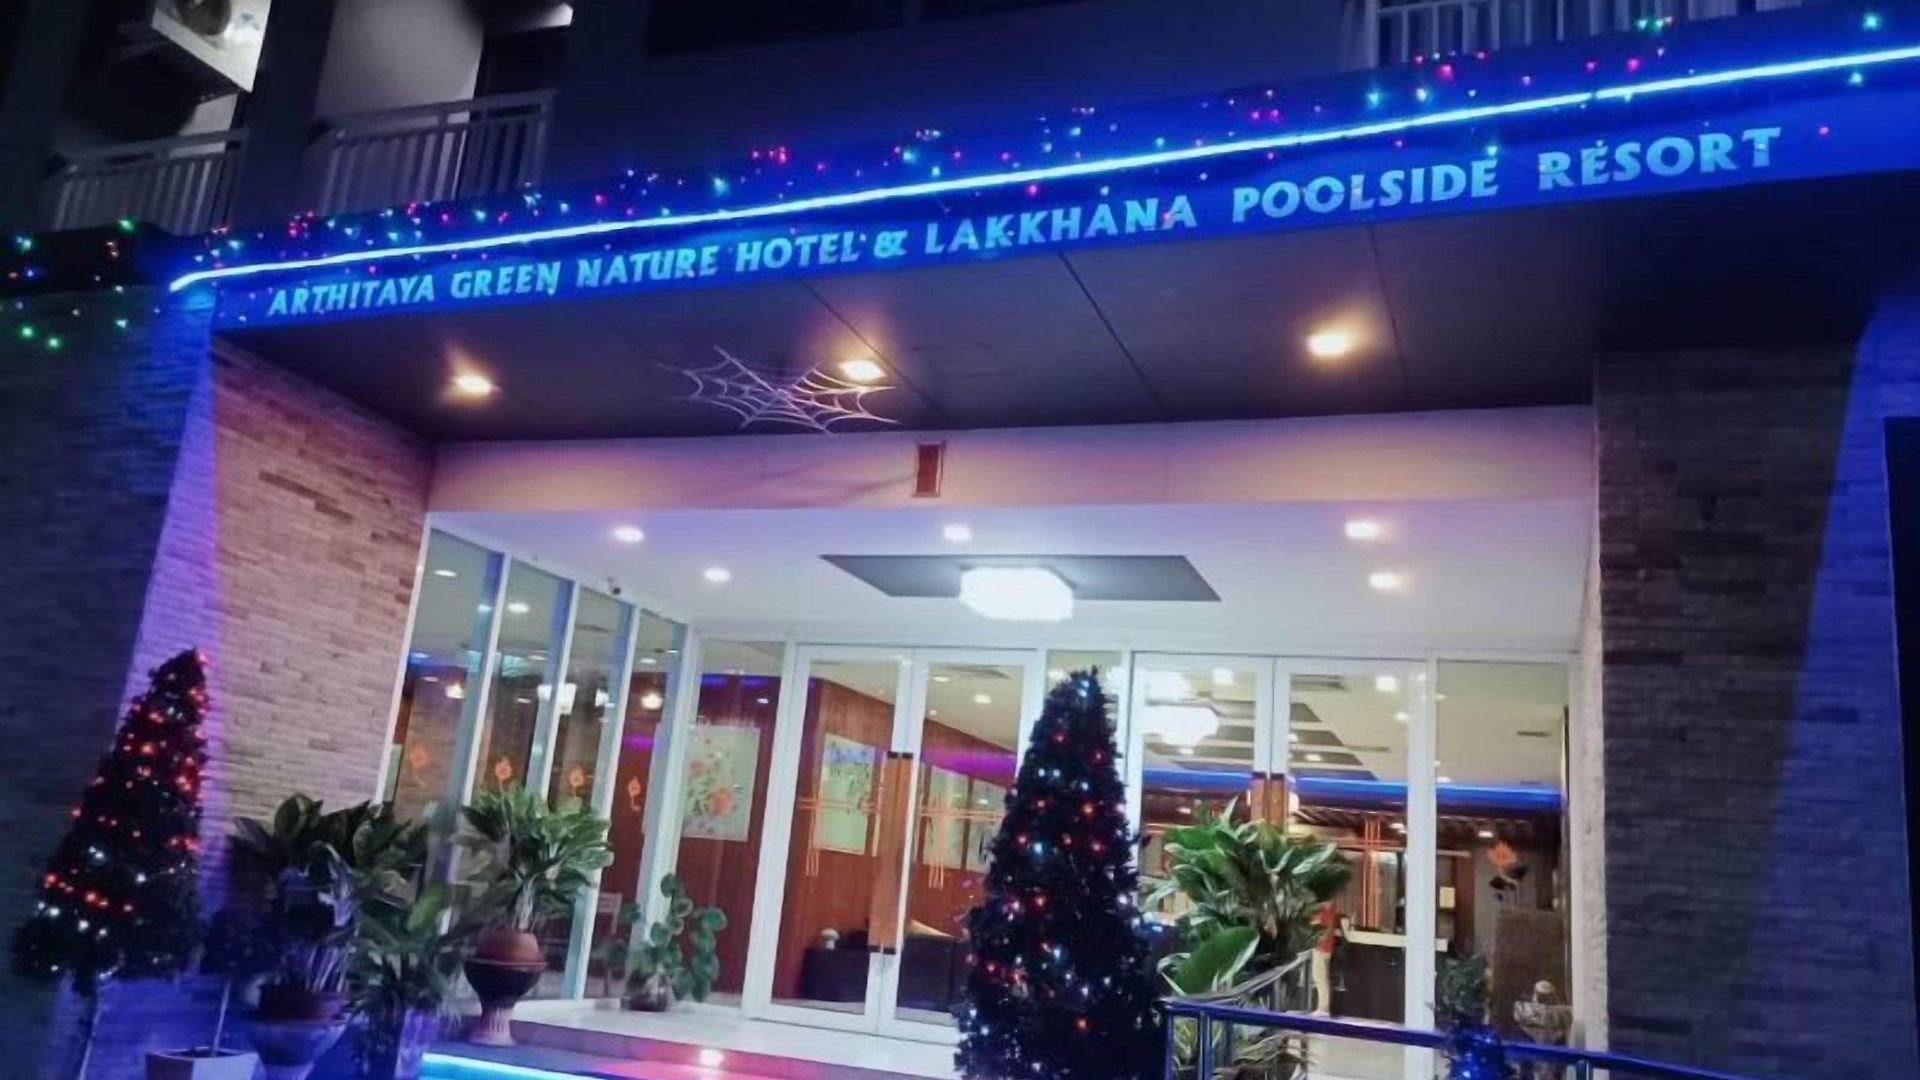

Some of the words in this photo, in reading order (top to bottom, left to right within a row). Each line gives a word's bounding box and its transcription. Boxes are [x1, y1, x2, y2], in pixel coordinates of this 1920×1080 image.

[269, 275, 434, 316] ARTHITAYA
[452, 261, 561, 299] GREEN
[576, 245, 718, 287] NATURE
[736, 231, 860, 271] HOTEL
[873, 231, 907, 258] &
[925, 195, 1196, 254] LAKKHANA
[1232, 158, 1498, 222] POOLSIDE
[1538, 127, 1780, 189] RESORT
